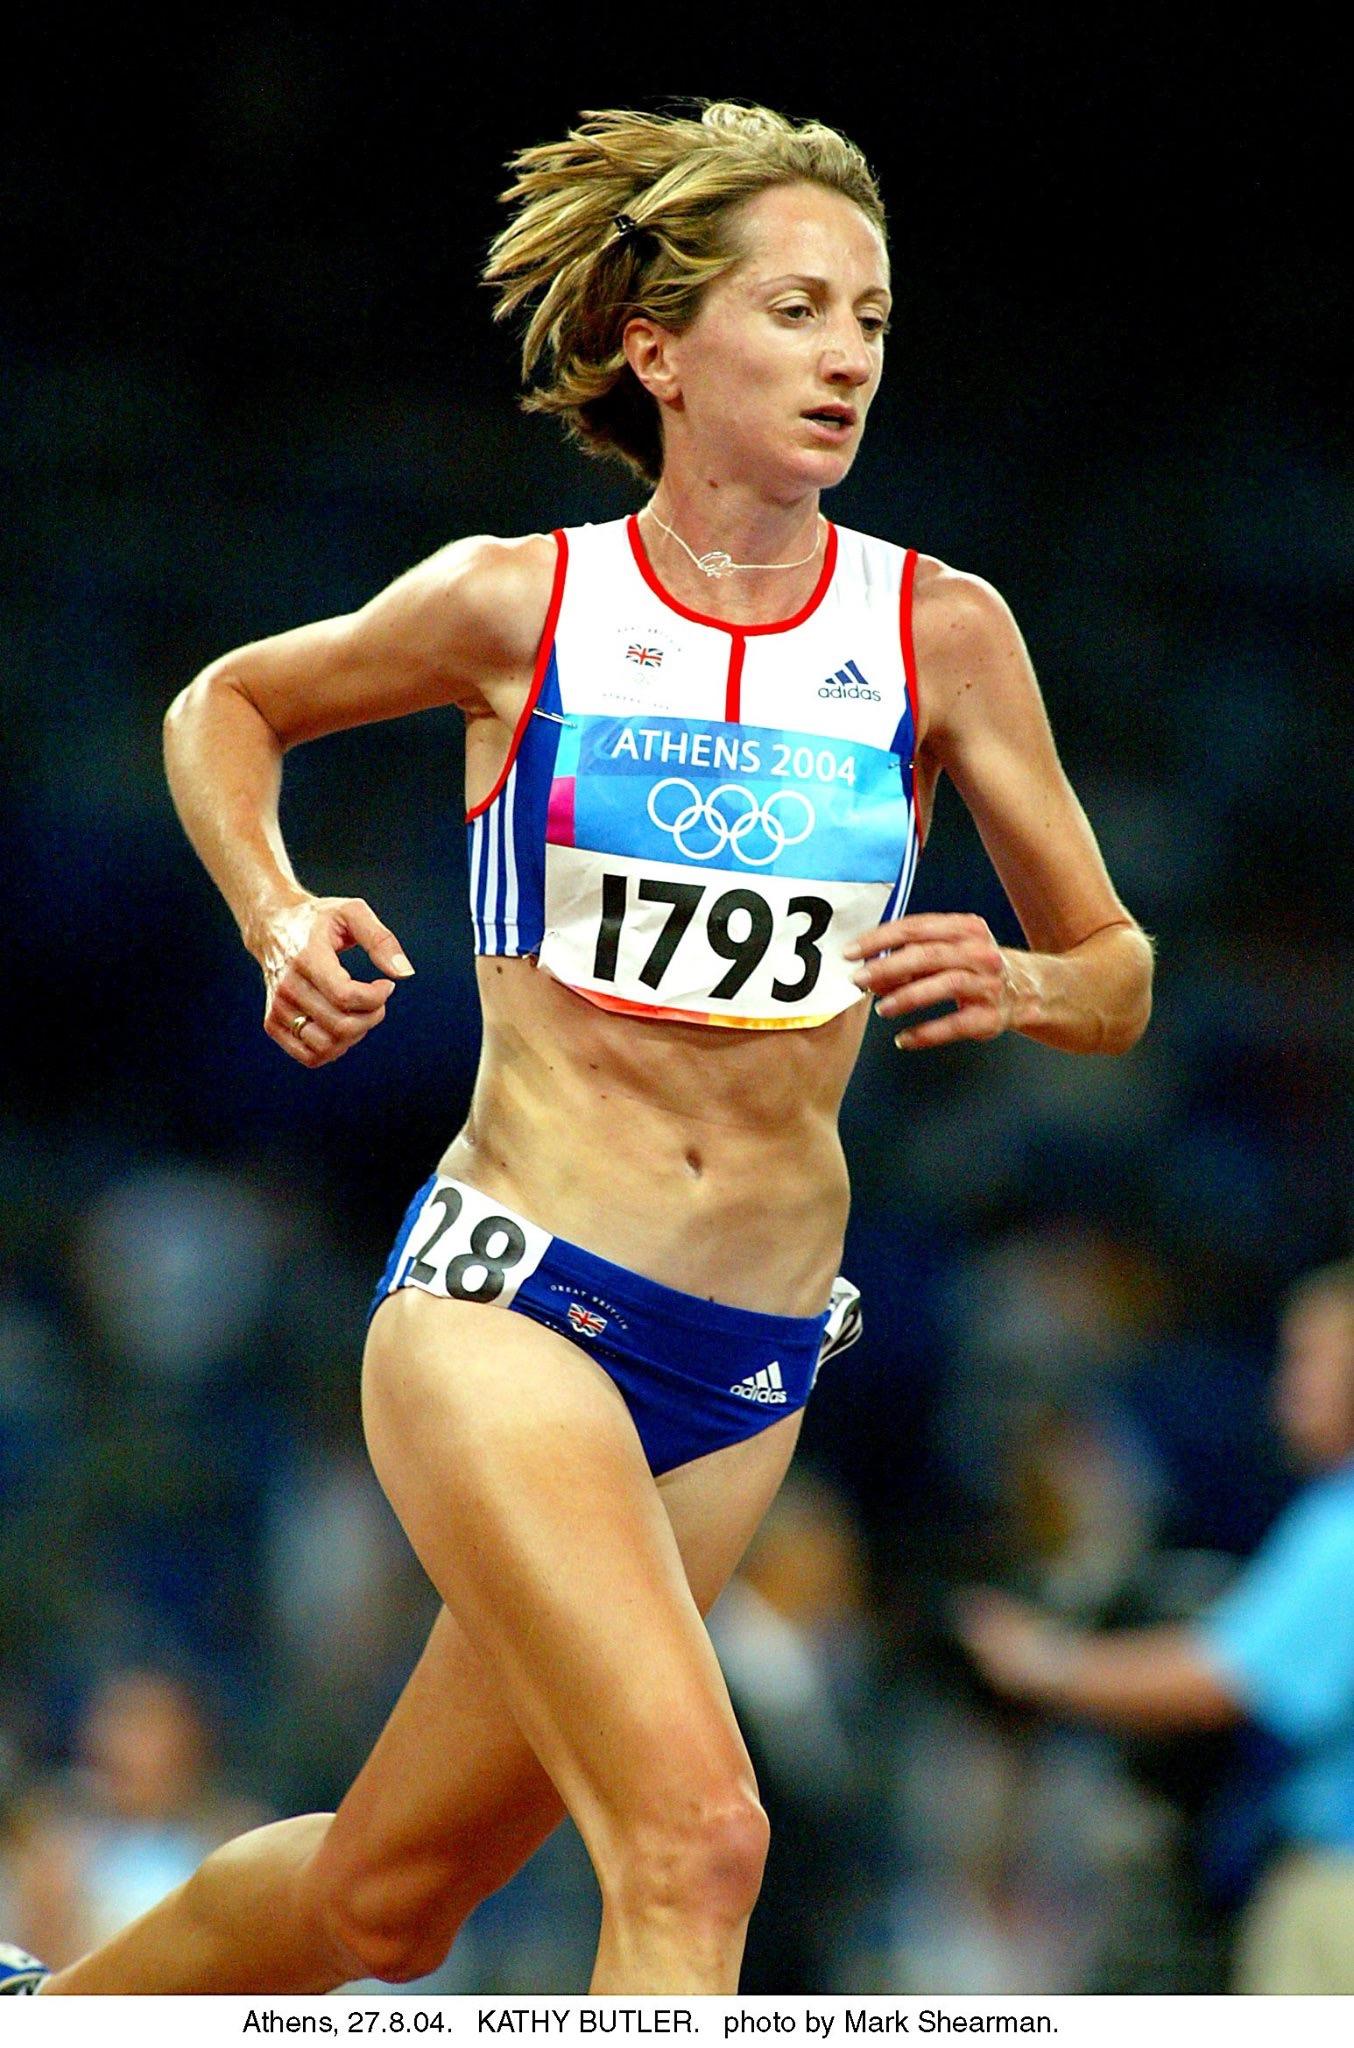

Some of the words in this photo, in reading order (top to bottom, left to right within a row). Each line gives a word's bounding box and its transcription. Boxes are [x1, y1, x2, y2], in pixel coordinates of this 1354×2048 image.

[817, 684, 882, 702] adidas
[610, 727, 762, 774] ATHENS
[769, 743, 857, 788] 2004
[593, 873, 834, 1003] 1793
[408, 1186, 527, 1304] 28
[550, 1284, 588, 1297] GREAT
[729, 1384, 788, 1404] adidas
